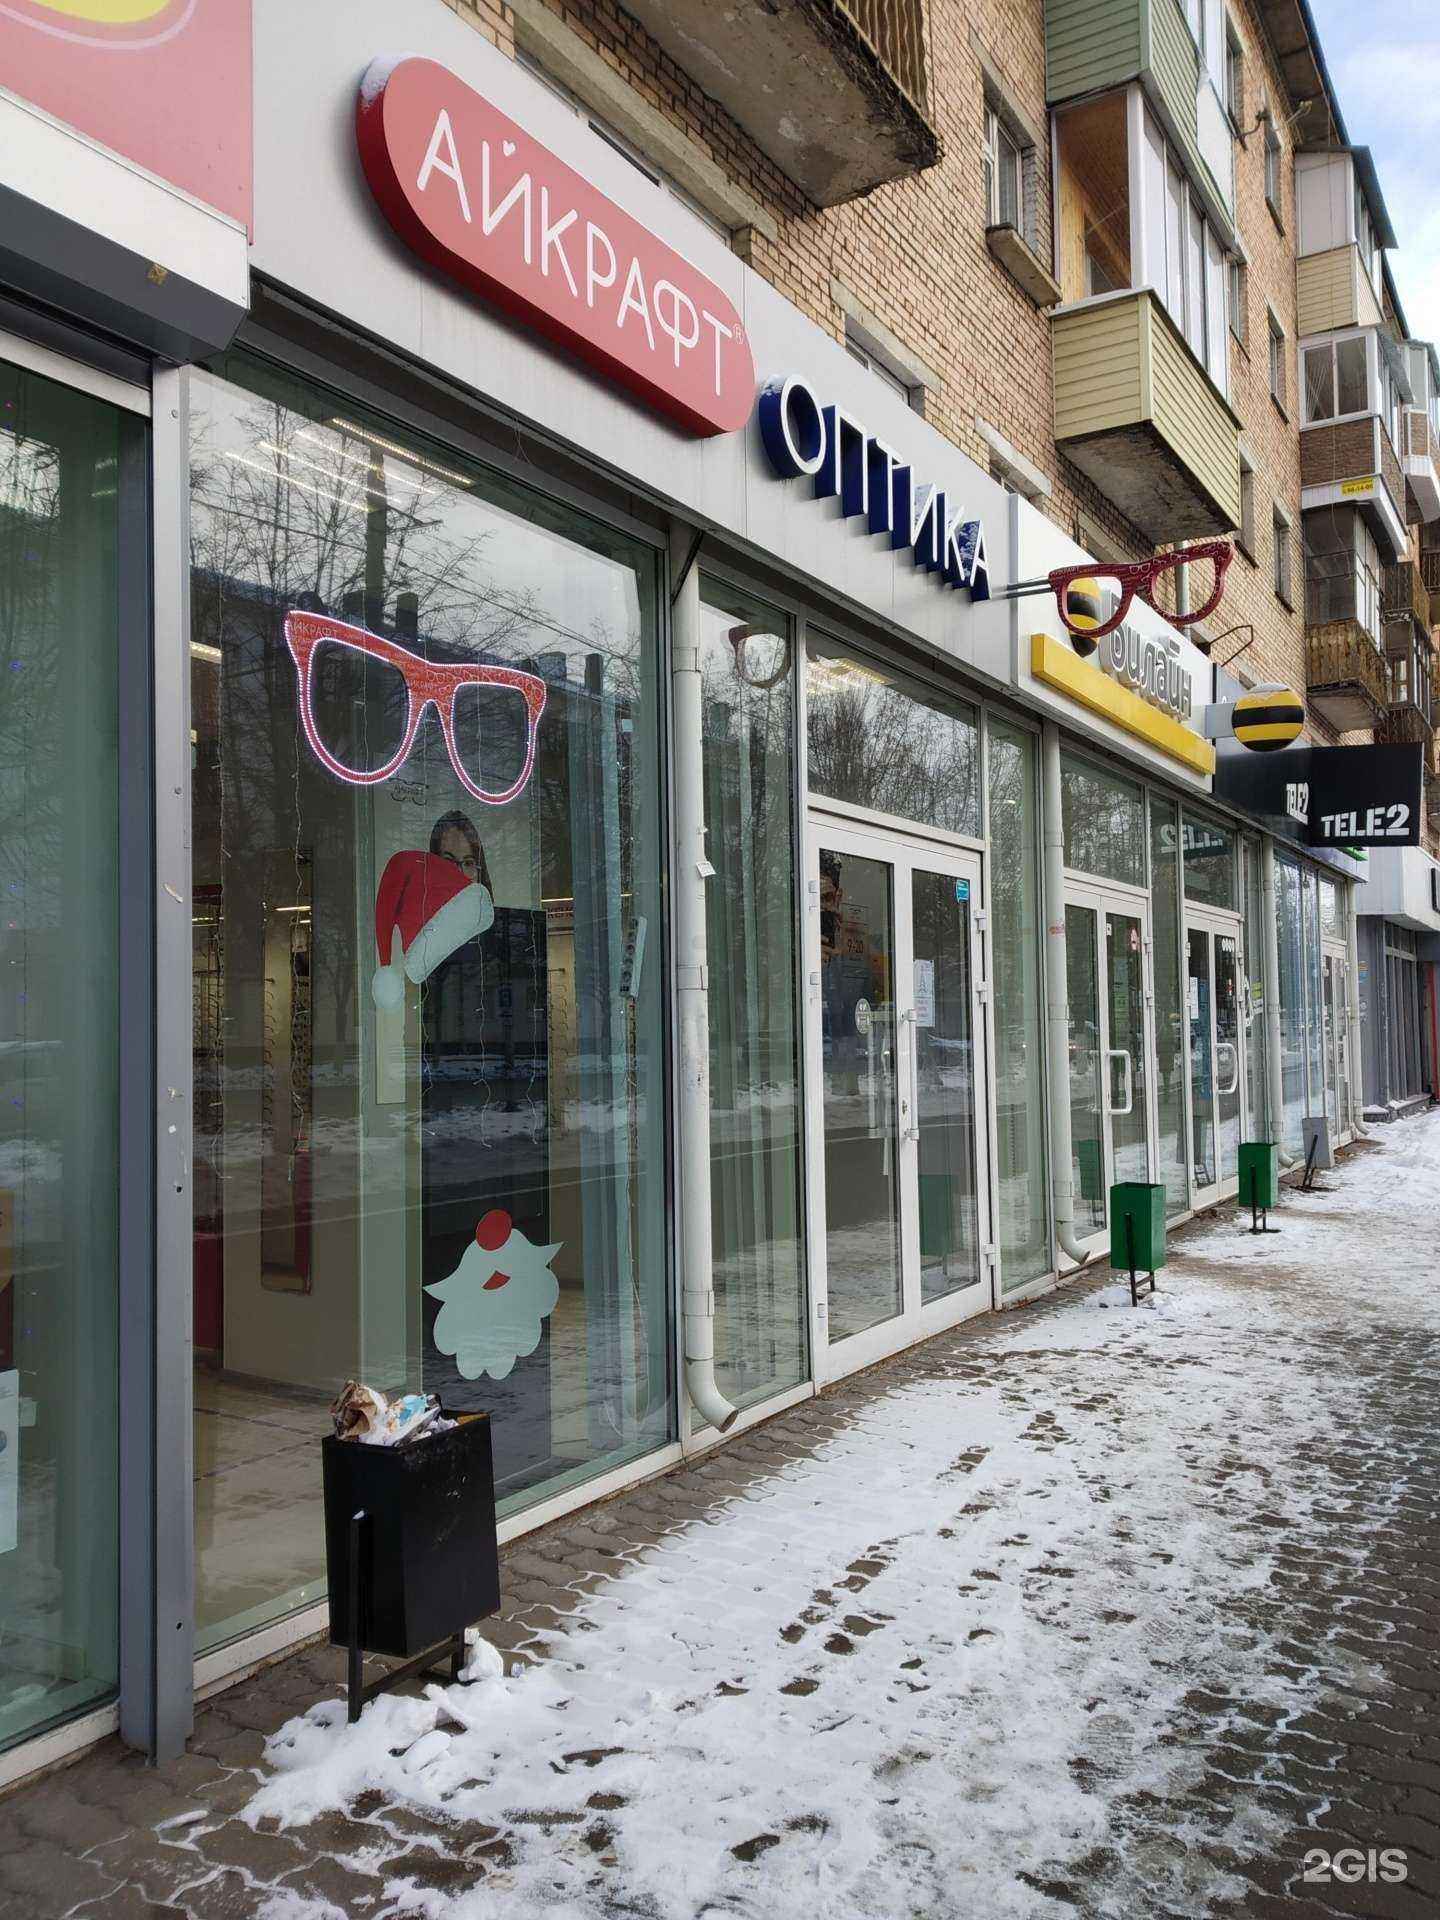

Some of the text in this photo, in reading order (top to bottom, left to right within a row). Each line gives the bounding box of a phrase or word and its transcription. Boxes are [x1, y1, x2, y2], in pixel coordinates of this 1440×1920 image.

[416, 108, 734, 396] АЙКРАФТ
[763, 373, 992, 601] ОПТИКА
[1321, 803, 1410, 837] TELE2
